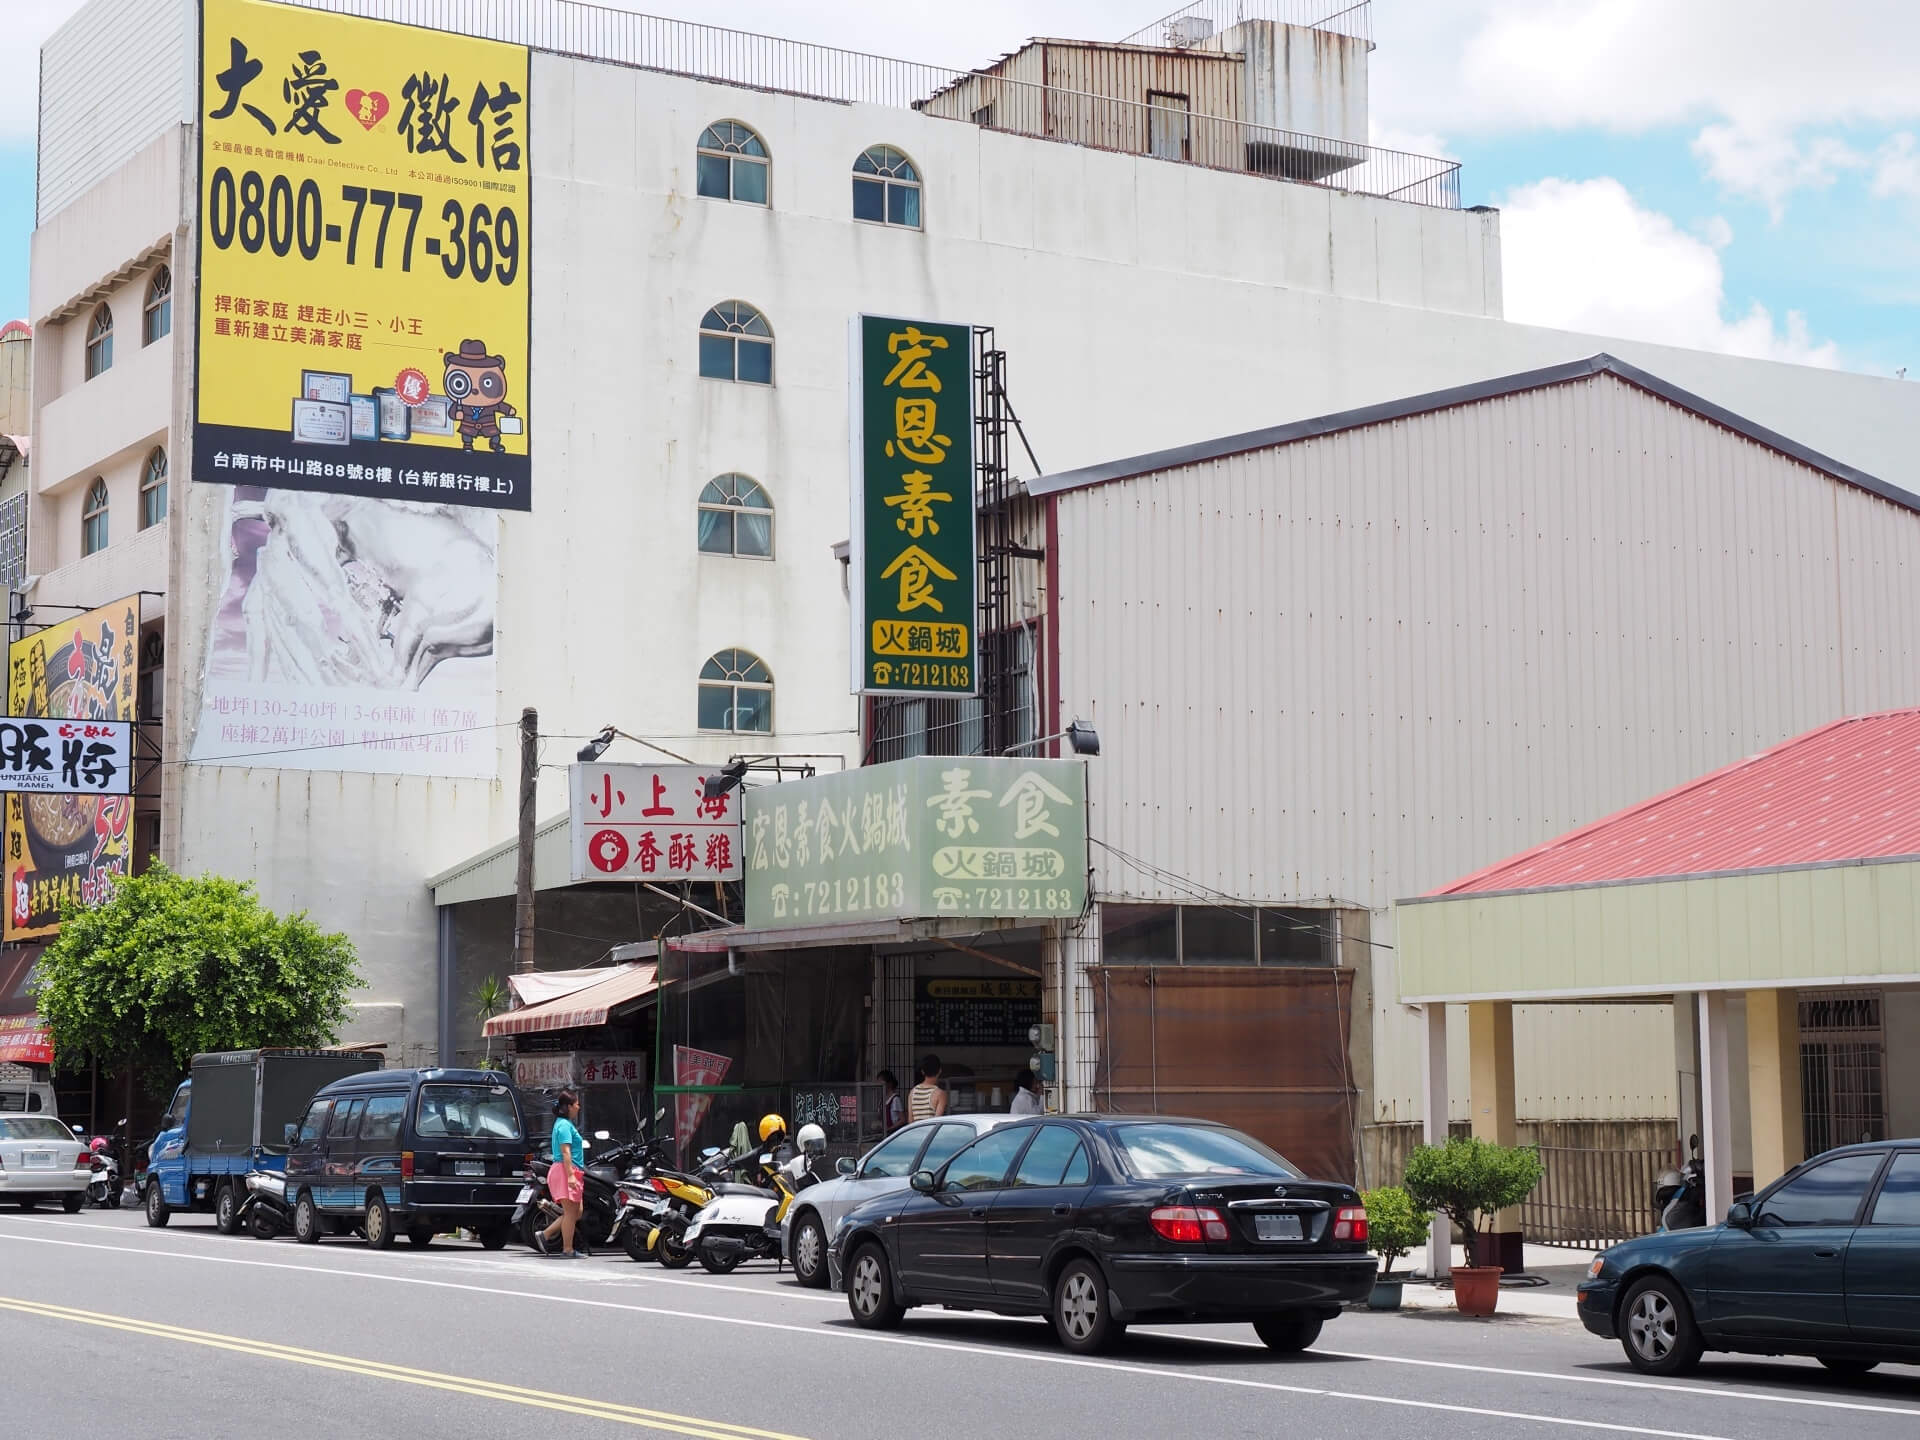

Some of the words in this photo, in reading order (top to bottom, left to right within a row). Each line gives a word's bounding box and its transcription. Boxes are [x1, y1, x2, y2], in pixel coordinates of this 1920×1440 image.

[209, 37, 342, 144] 大愛
[397, 71, 521, 172] 徵信
[210, 166, 519, 285] 0800-777-369
[214, 294, 289, 320] 捍衛家庭
[297, 304, 423, 336] 趕走小三、小王
[214, 317, 363, 351] 重新建立美滿家庭
[213, 451, 392, 484] 台南市中山路88號8樓
[398, 469, 514, 495] (台新銀行樓上)
[880, 326, 958, 613] 宏恩素食
[879, 624, 961, 653] 火鍋城
[58, 724, 116, 739] らーめん
[590, 773, 730, 820] 小上海
[926, 768, 1073, 839] 素食
[752, 784, 910, 870] 宏恩素食火鍋城
[634, 831, 734, 873] 香酥雞
[943, 849, 1057, 878] 火鍋城
[584, 1059, 638, 1081] 香酥雞
